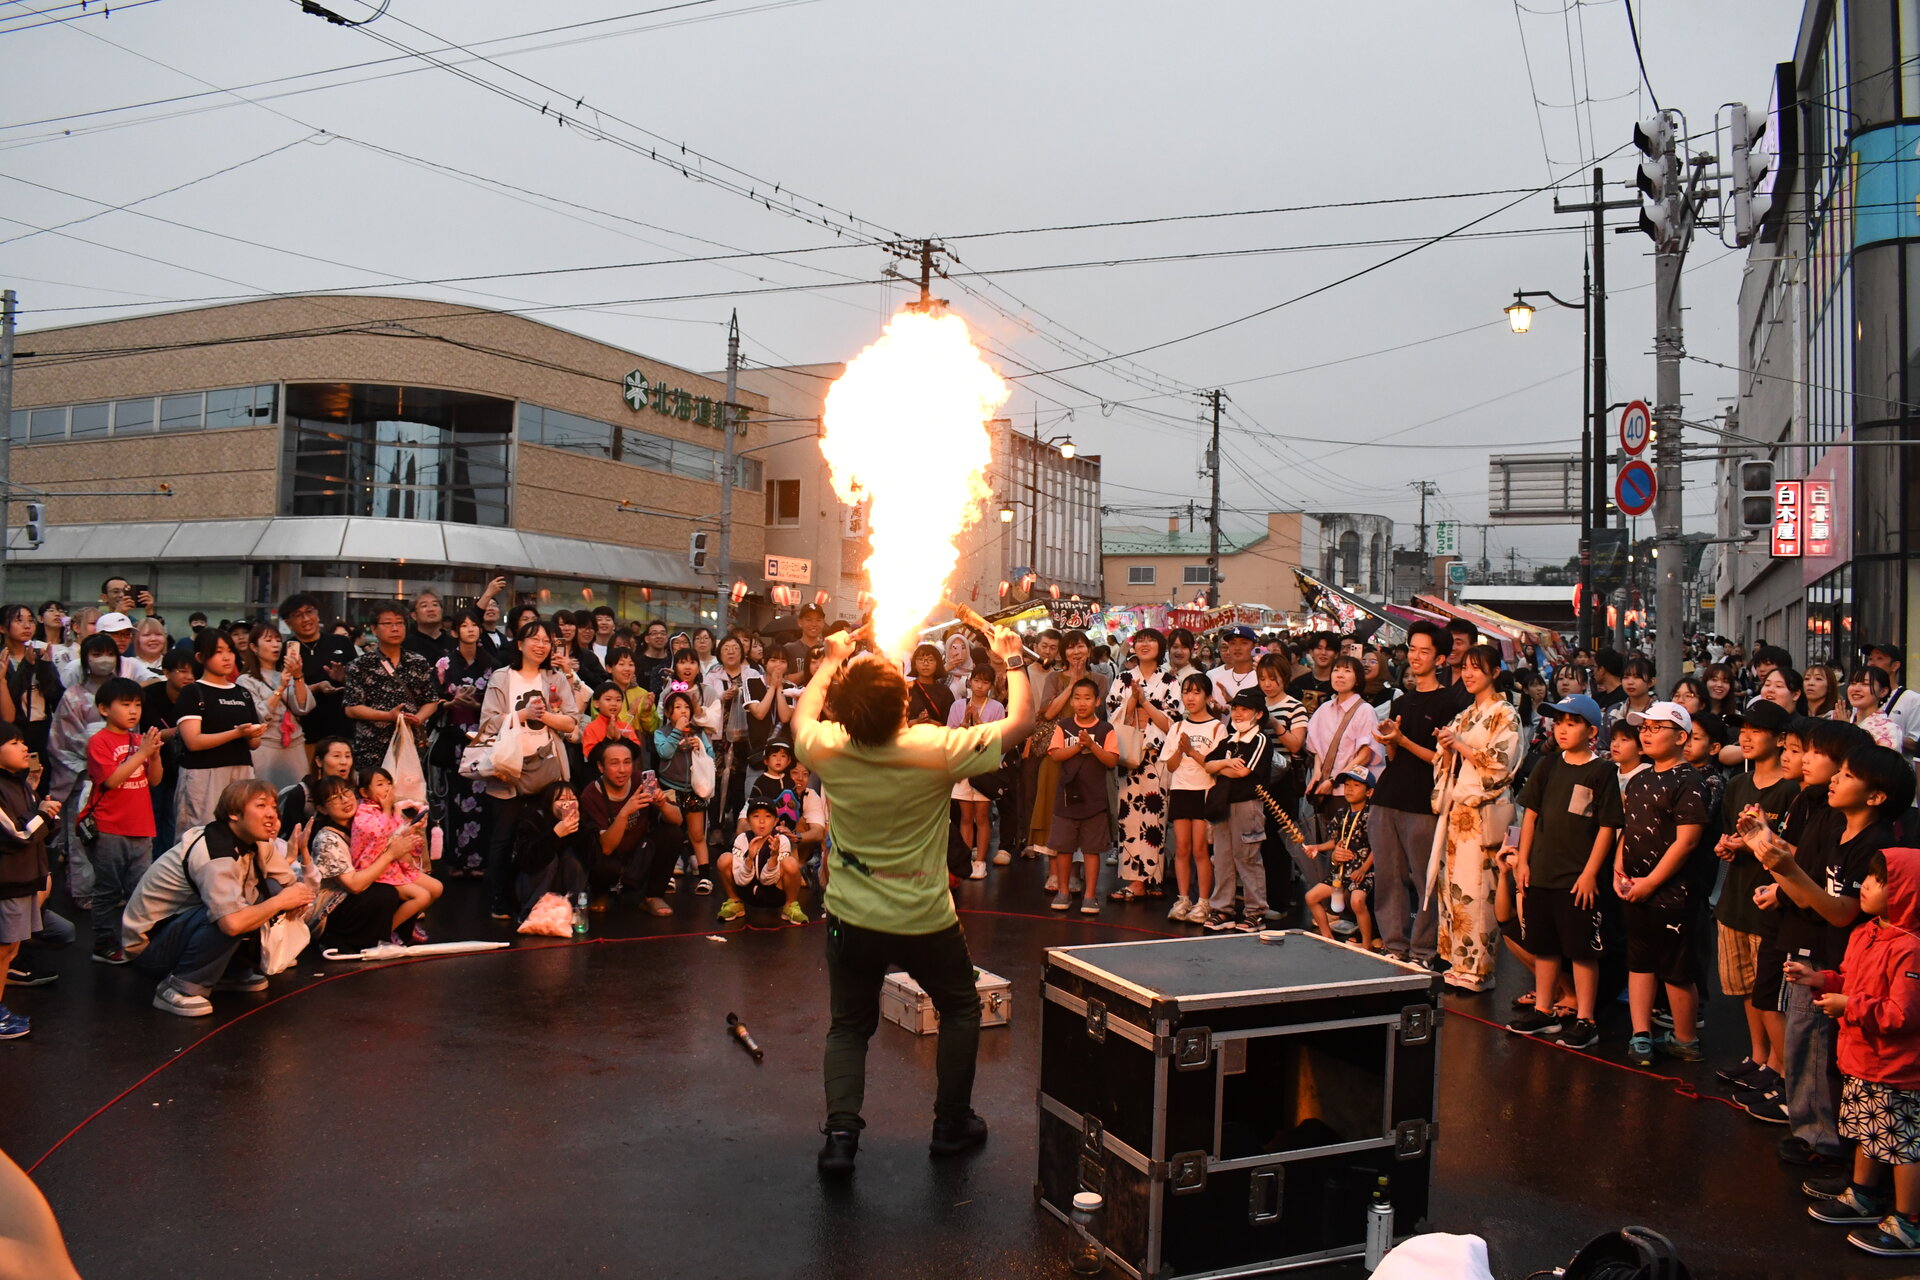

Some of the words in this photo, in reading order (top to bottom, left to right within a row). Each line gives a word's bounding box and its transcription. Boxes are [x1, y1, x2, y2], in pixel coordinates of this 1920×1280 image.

[1626, 415, 1644, 440] 40
[1776, 485, 1797, 541] 白木屋
[1778, 543, 1795, 554] 1F
